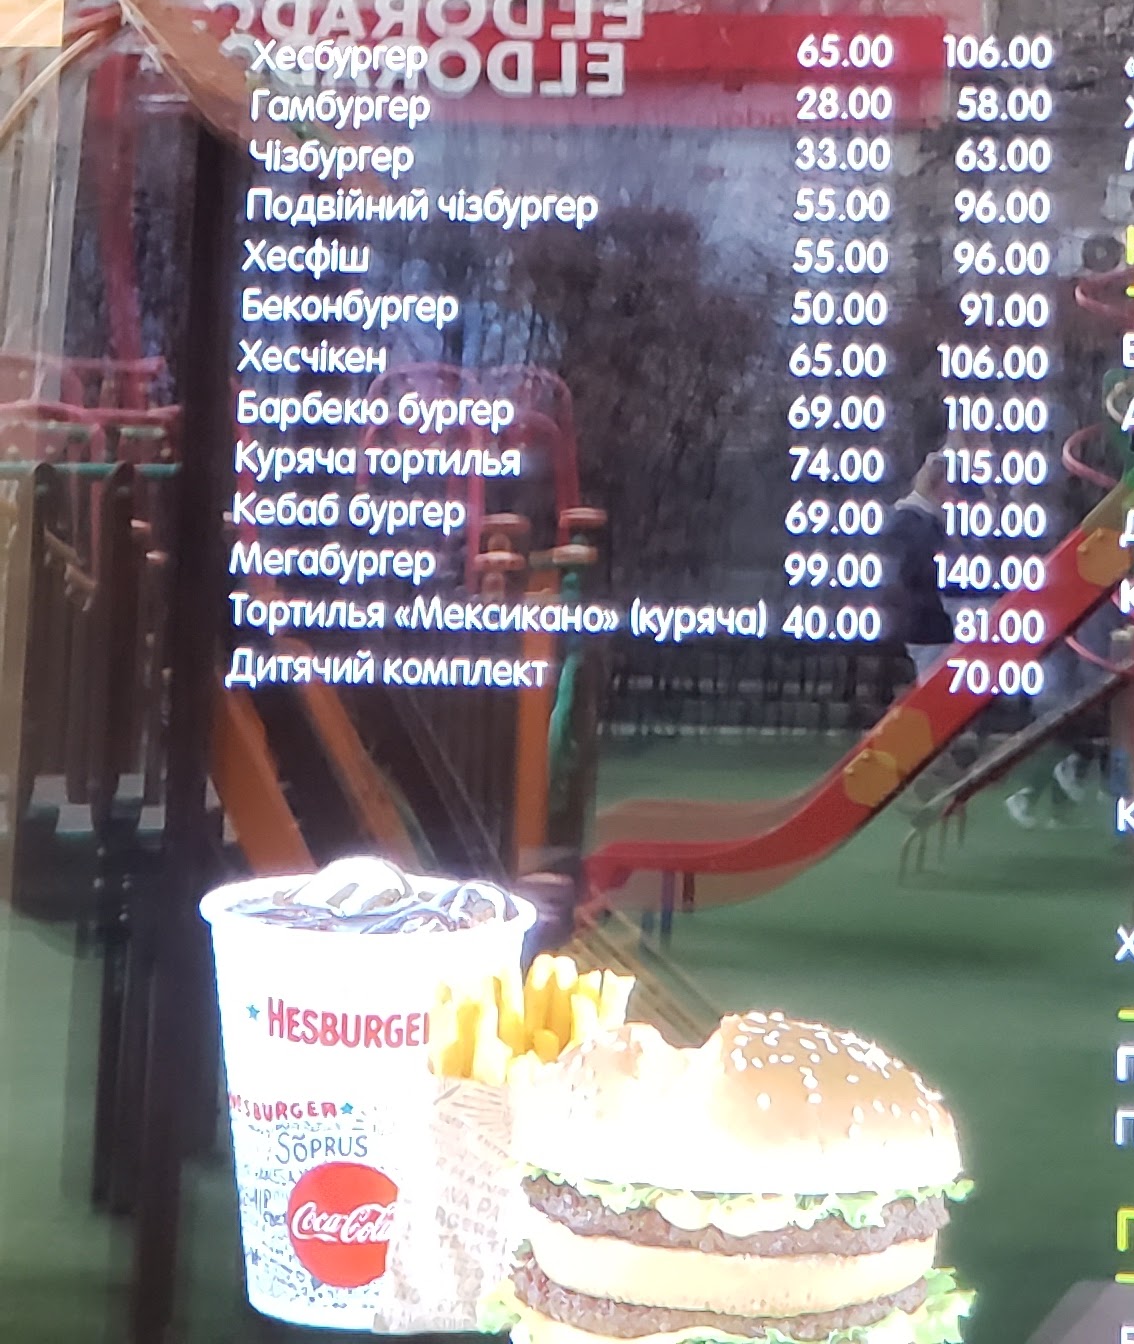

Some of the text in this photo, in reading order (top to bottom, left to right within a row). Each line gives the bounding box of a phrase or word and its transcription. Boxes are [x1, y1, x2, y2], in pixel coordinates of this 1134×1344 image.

[251, 35, 1053, 82] Хесбургер 65.00 106.00
[250, 87, 1052, 133] Гамбургер 28.00 58.00
[248, 138, 1051, 183] Чізбургер 33.00 63.00
[245, 187, 1051, 231] Подвійний чізбургер 55.00 96.00
[241, 241, 1050, 279] Хесфіш 55.00 96.00
[241, 289, 1048, 331] Беконбургер 50.00 91.00
[236, 342, 1048, 380] Хесчікен 65.00 106.00
[237, 391, 1048, 435] Барбекю бургер 69.00 110.00
[235, 443, 1047, 486] Куряча тортилья 74.00 115.00
[233, 493, 1047, 539] Кебаб бургер 69.00 110.00
[229, 544, 1047, 592] Мегабургер 99.00 140.00
[227, 593, 1045, 645] Тортилья «Мексикано» (куряча) 40.00 81.00
[225, 649, 1045, 697] Дитячий комплект 70.00
